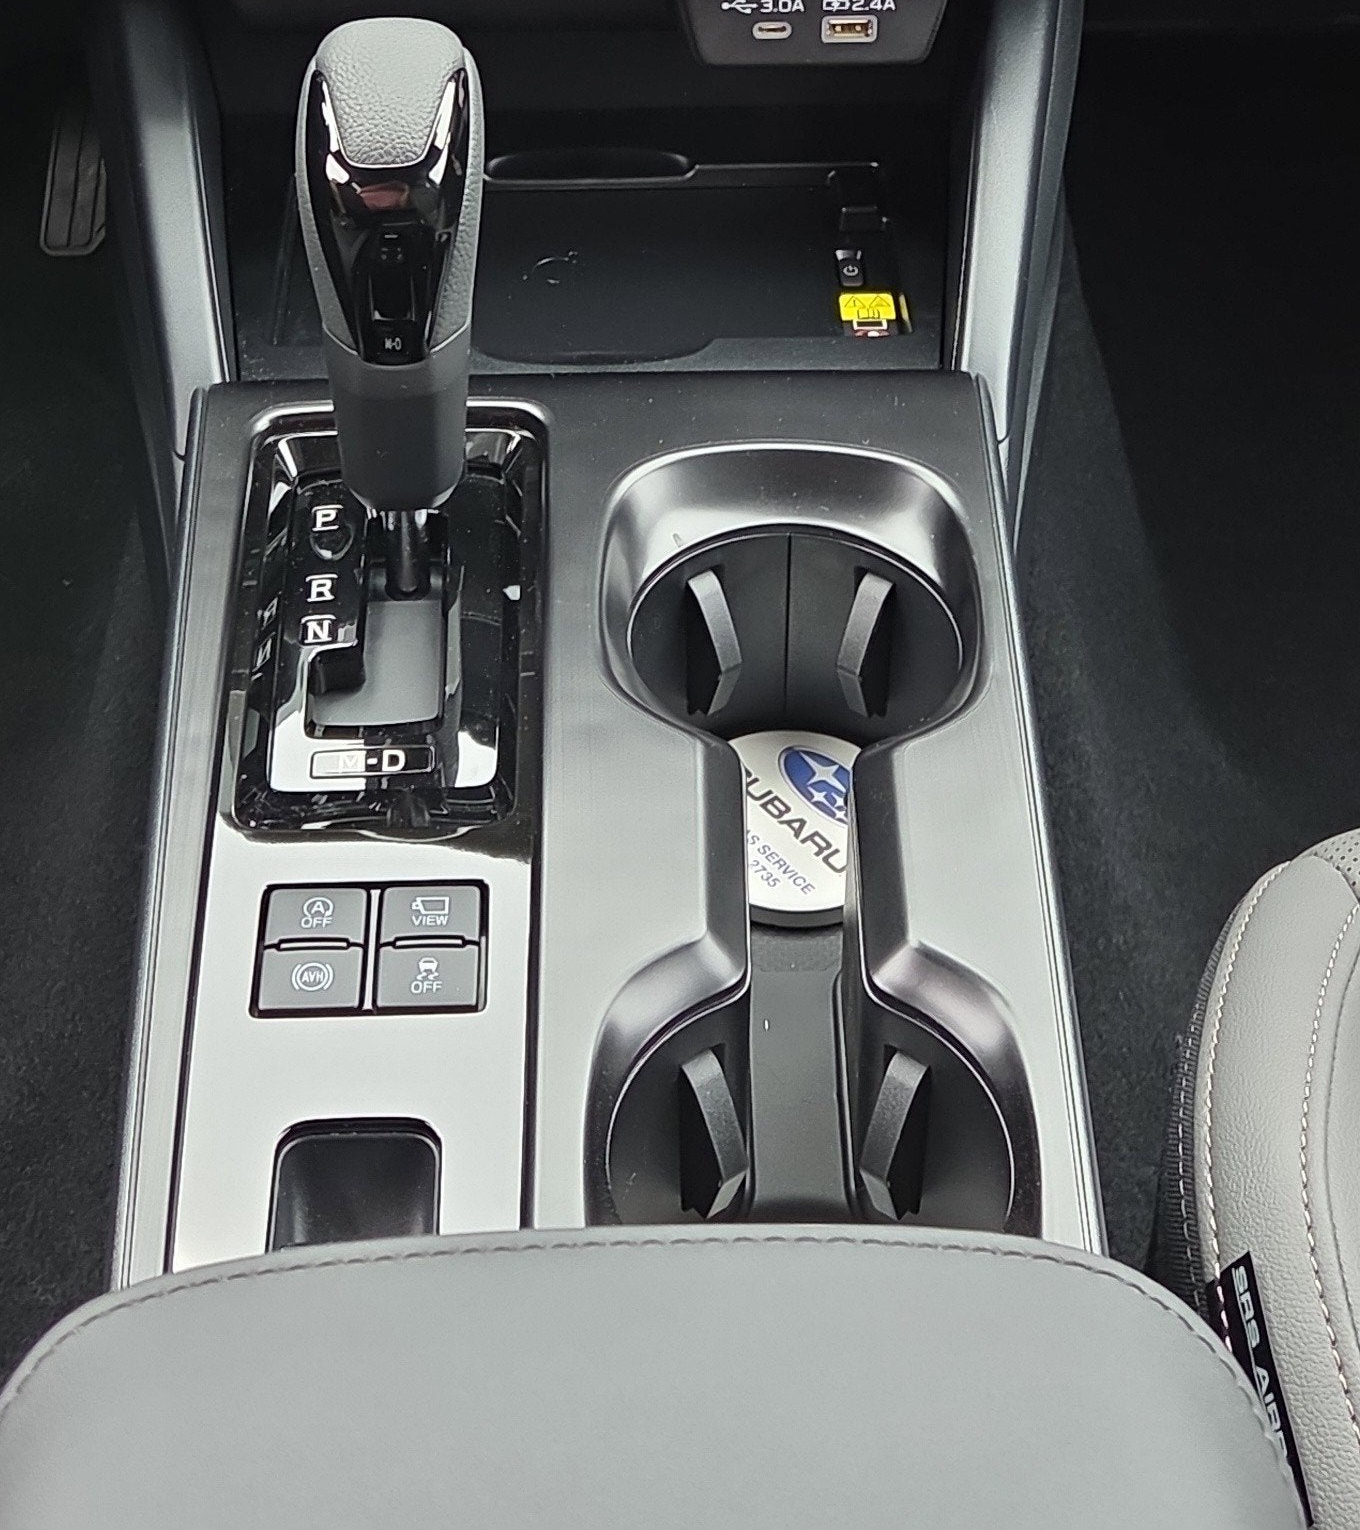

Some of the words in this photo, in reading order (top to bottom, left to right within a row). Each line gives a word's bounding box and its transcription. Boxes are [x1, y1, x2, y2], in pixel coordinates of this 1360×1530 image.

[313, 509, 339, 530] P
[309, 579, 335, 601] R
[304, 621, 334, 643] N
[757, 842, 816, 896] SERVICE
[301, 917, 333, 929] OFF
[412, 915, 449, 927] VIEW
[301, 970, 324, 982] AVH
[411, 981, 443, 994] OFF
